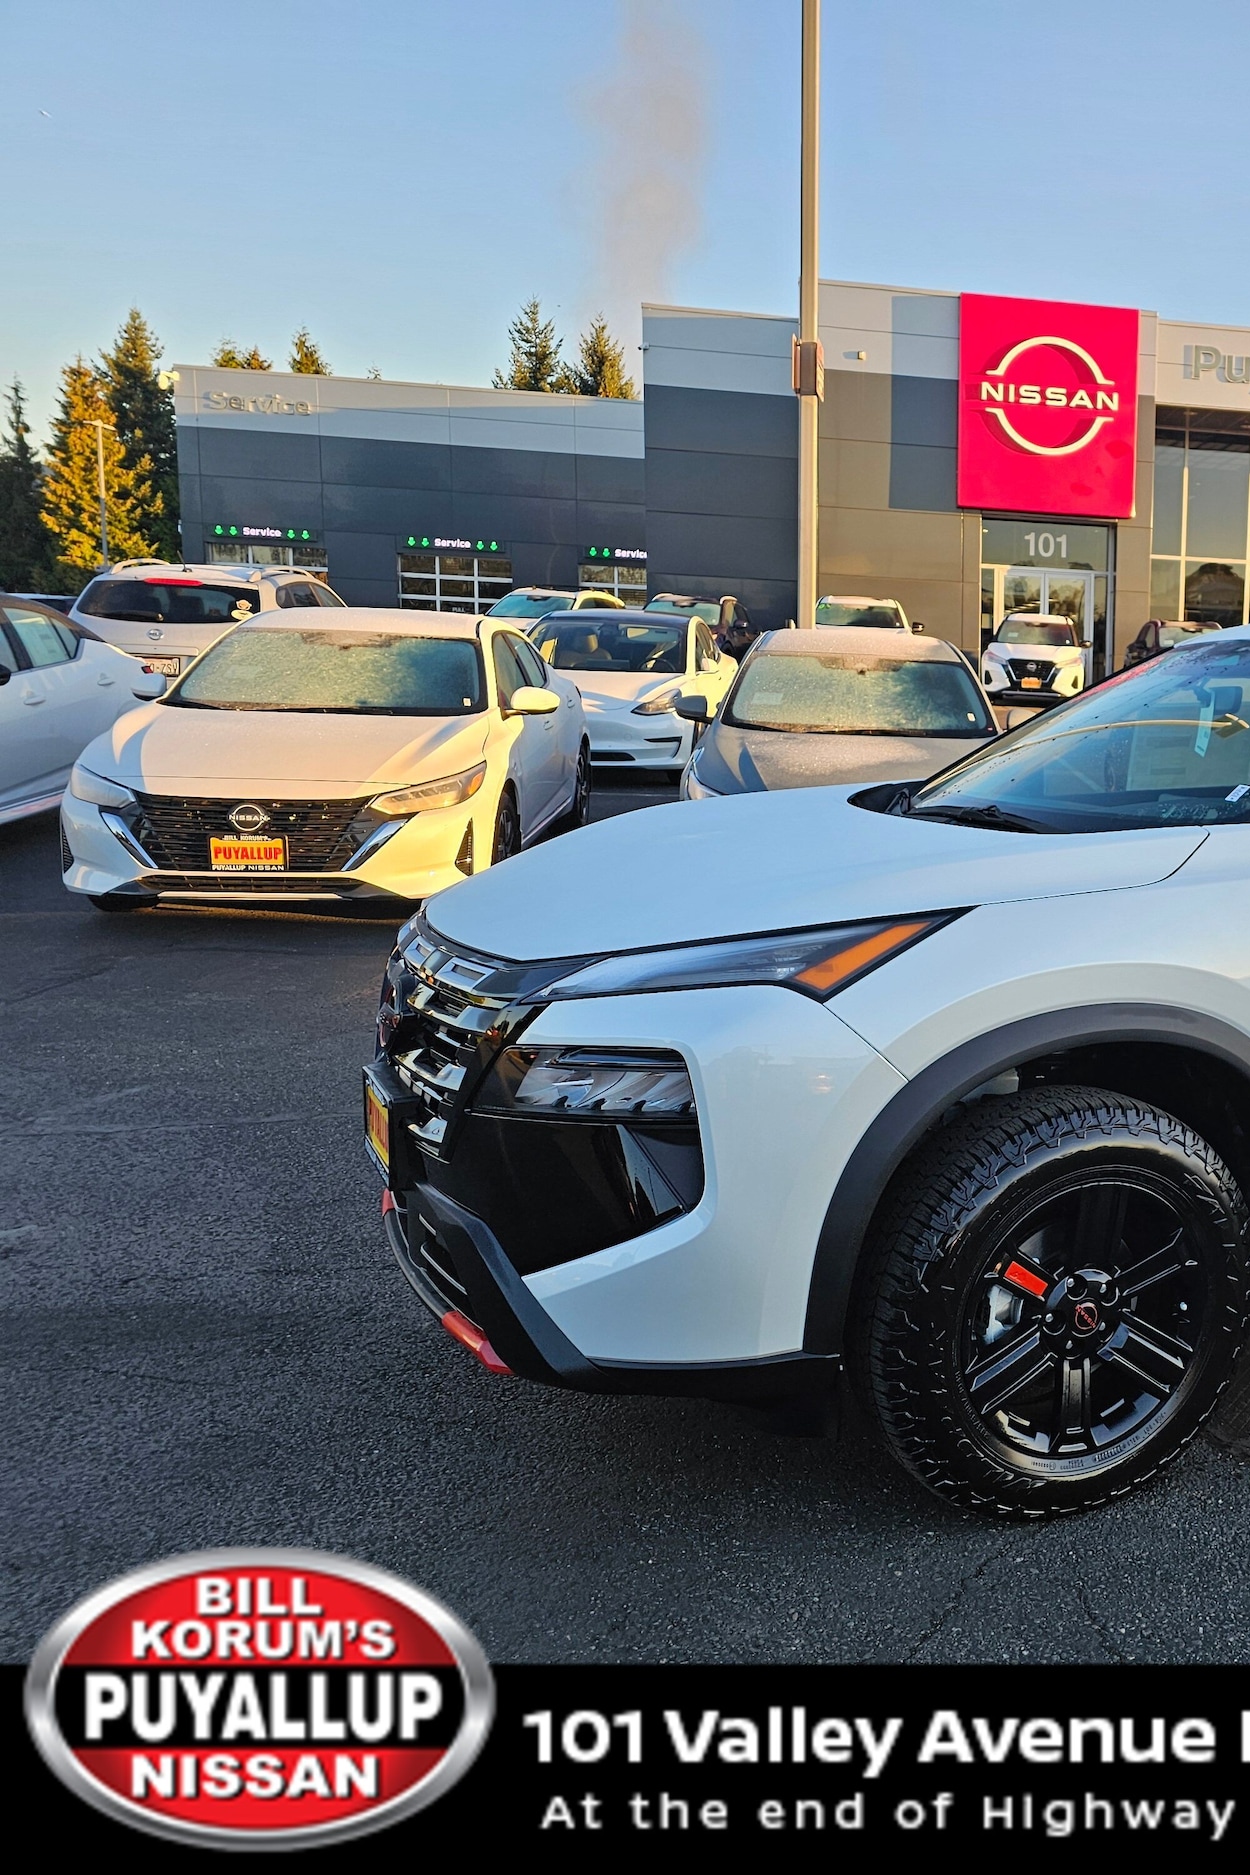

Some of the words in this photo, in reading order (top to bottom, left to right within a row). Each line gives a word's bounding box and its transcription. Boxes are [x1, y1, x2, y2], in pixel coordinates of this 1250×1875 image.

[206, 391, 313, 416] Service
[981, 381, 1119, 411] NISSAN
[242, 526, 282, 537] Service
[434, 538, 471, 549] Service
[1024, 532, 1068, 558] 101
[213, 847, 283, 860] PUYALLUP
